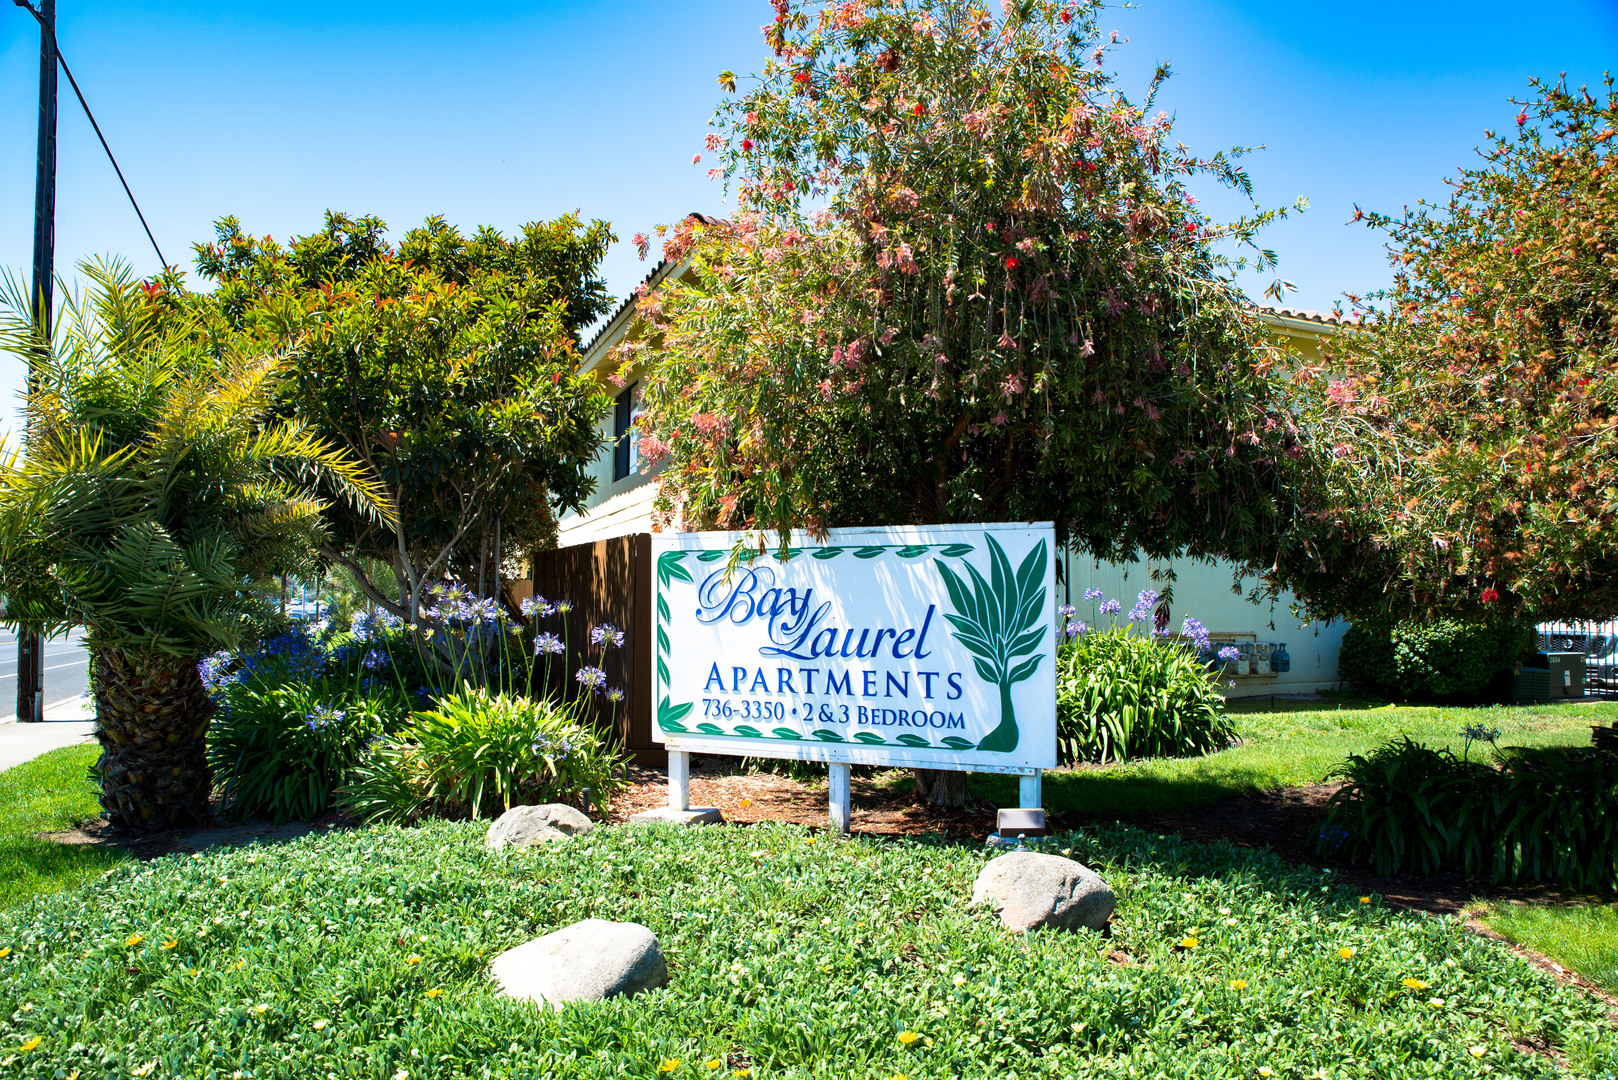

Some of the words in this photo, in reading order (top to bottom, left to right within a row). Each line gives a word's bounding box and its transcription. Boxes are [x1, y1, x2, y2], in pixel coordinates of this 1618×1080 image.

[696, 566, 812, 631] Bay
[759, 601, 936, 660] Laurel
[704, 661, 963, 700] APARTMENTS
[702, 698, 785, 721] 736-3350
[857, 706, 966, 730] BEDROOM
